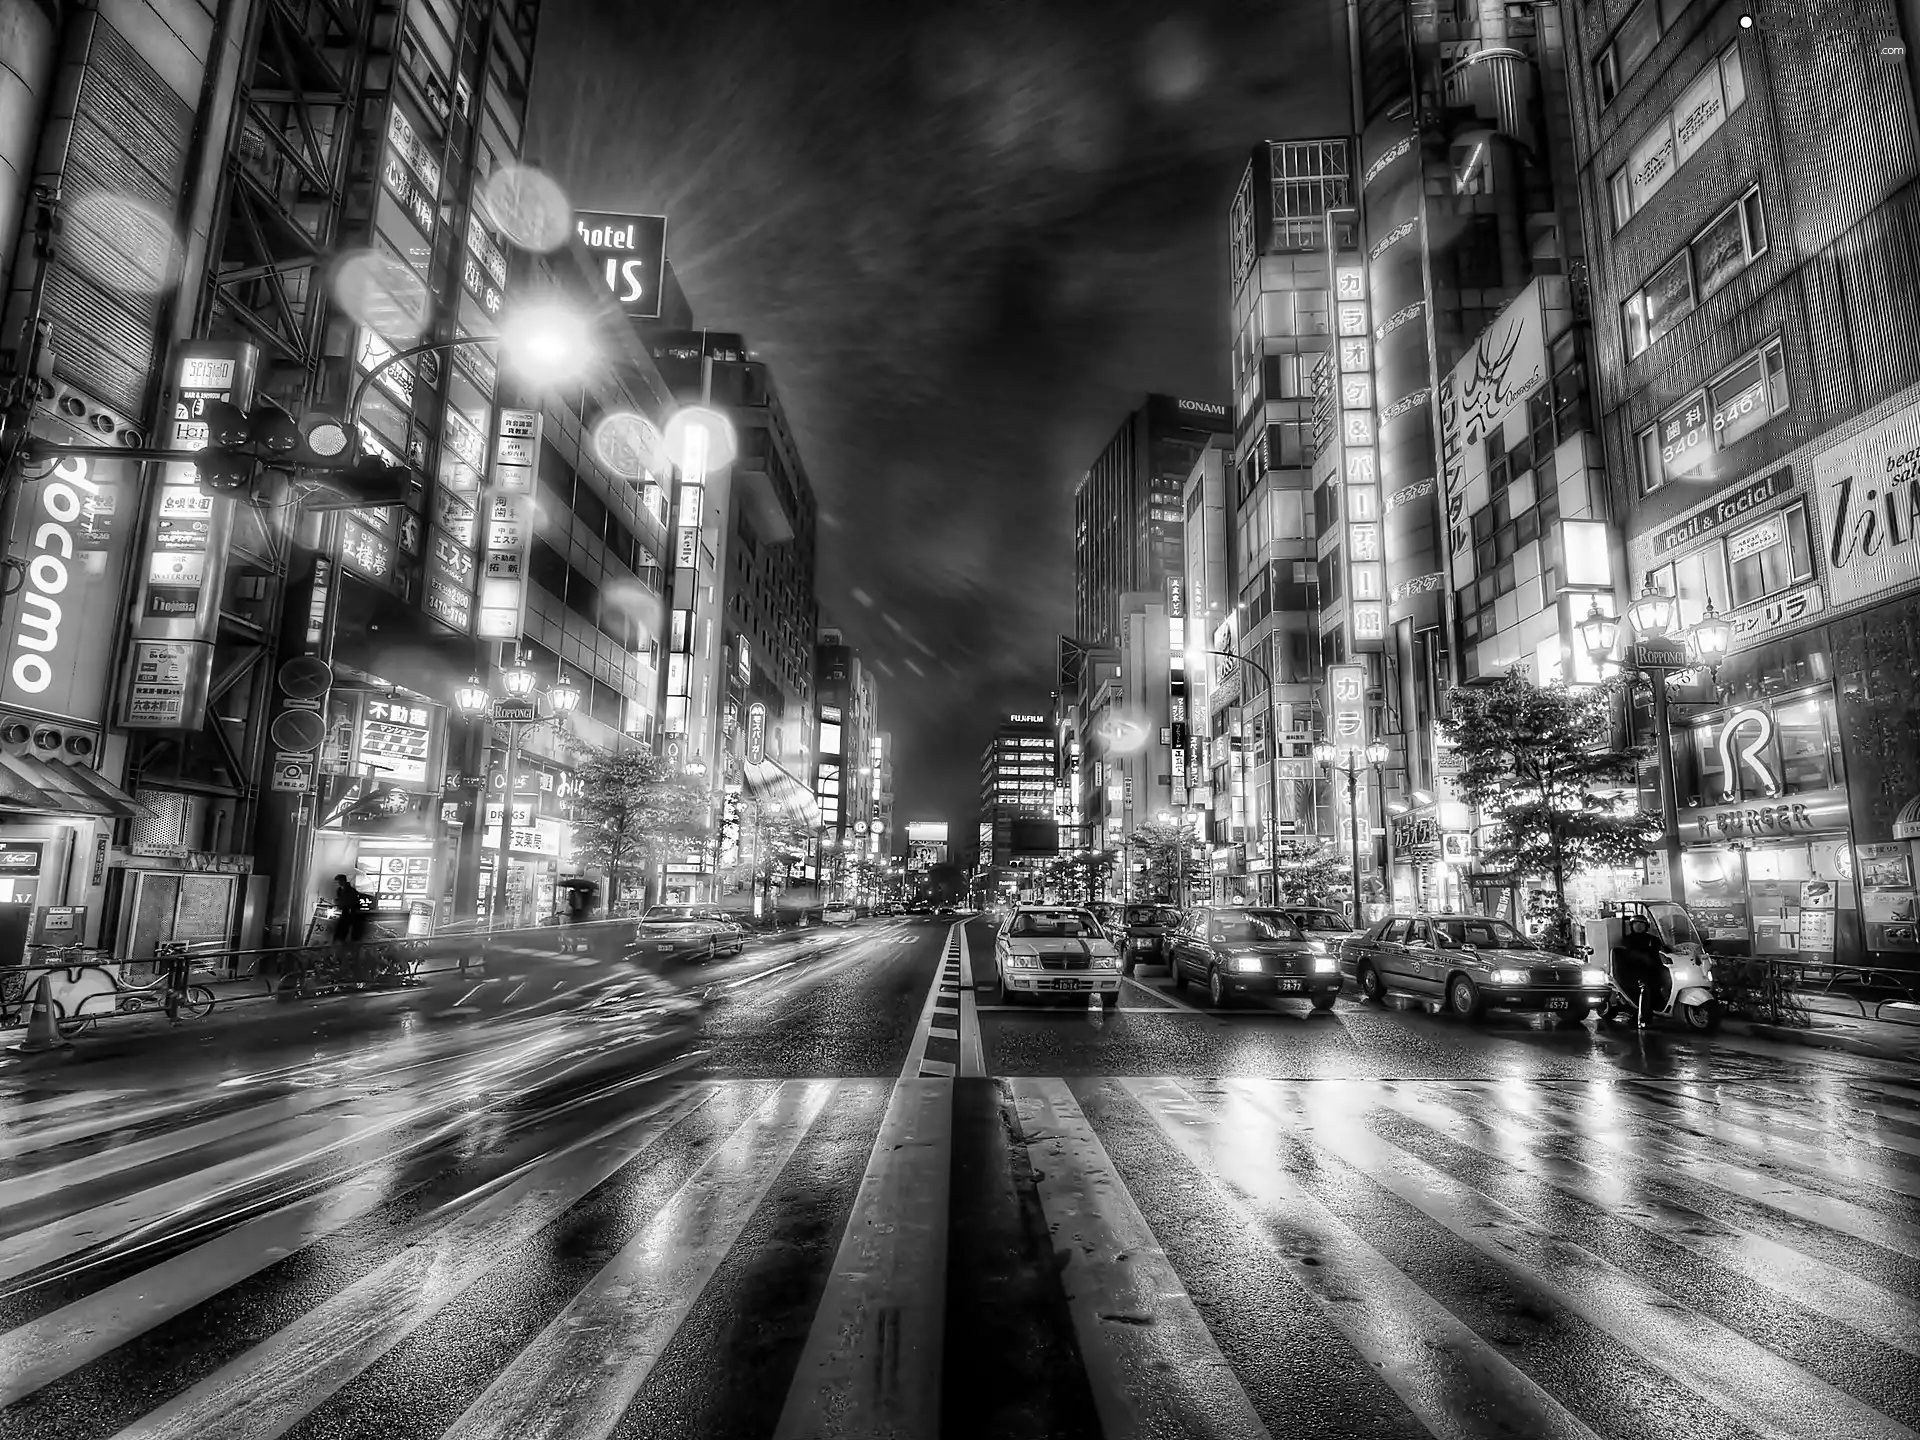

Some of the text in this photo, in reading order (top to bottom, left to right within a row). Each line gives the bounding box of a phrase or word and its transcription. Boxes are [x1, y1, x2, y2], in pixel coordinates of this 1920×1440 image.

[578, 221, 635, 250] hotel
[1179, 399, 1225, 415] KONAMI
[1665, 517, 1699, 551] nail
[1703, 516, 1714, 530] &
[1717, 477, 1775, 522] facial
[436, 537, 472, 575] エステ
[681, 531, 693, 563] Kelly
[12, 443, 100, 693] docomo
[1765, 594, 1807, 625] リラ
[1638, 646, 1685, 664] ROPPONGI
[369, 701, 428, 727] 不動産
[494, 705, 532, 719] ROPPONGI
[1010, 714, 1044, 723] FUJIFILM
[751, 715, 761, 760] モスバーガー
[1719, 709, 1781, 801] R
[490, 811, 525, 820] DRGS
[1716, 803, 1809, 832] BURGER
